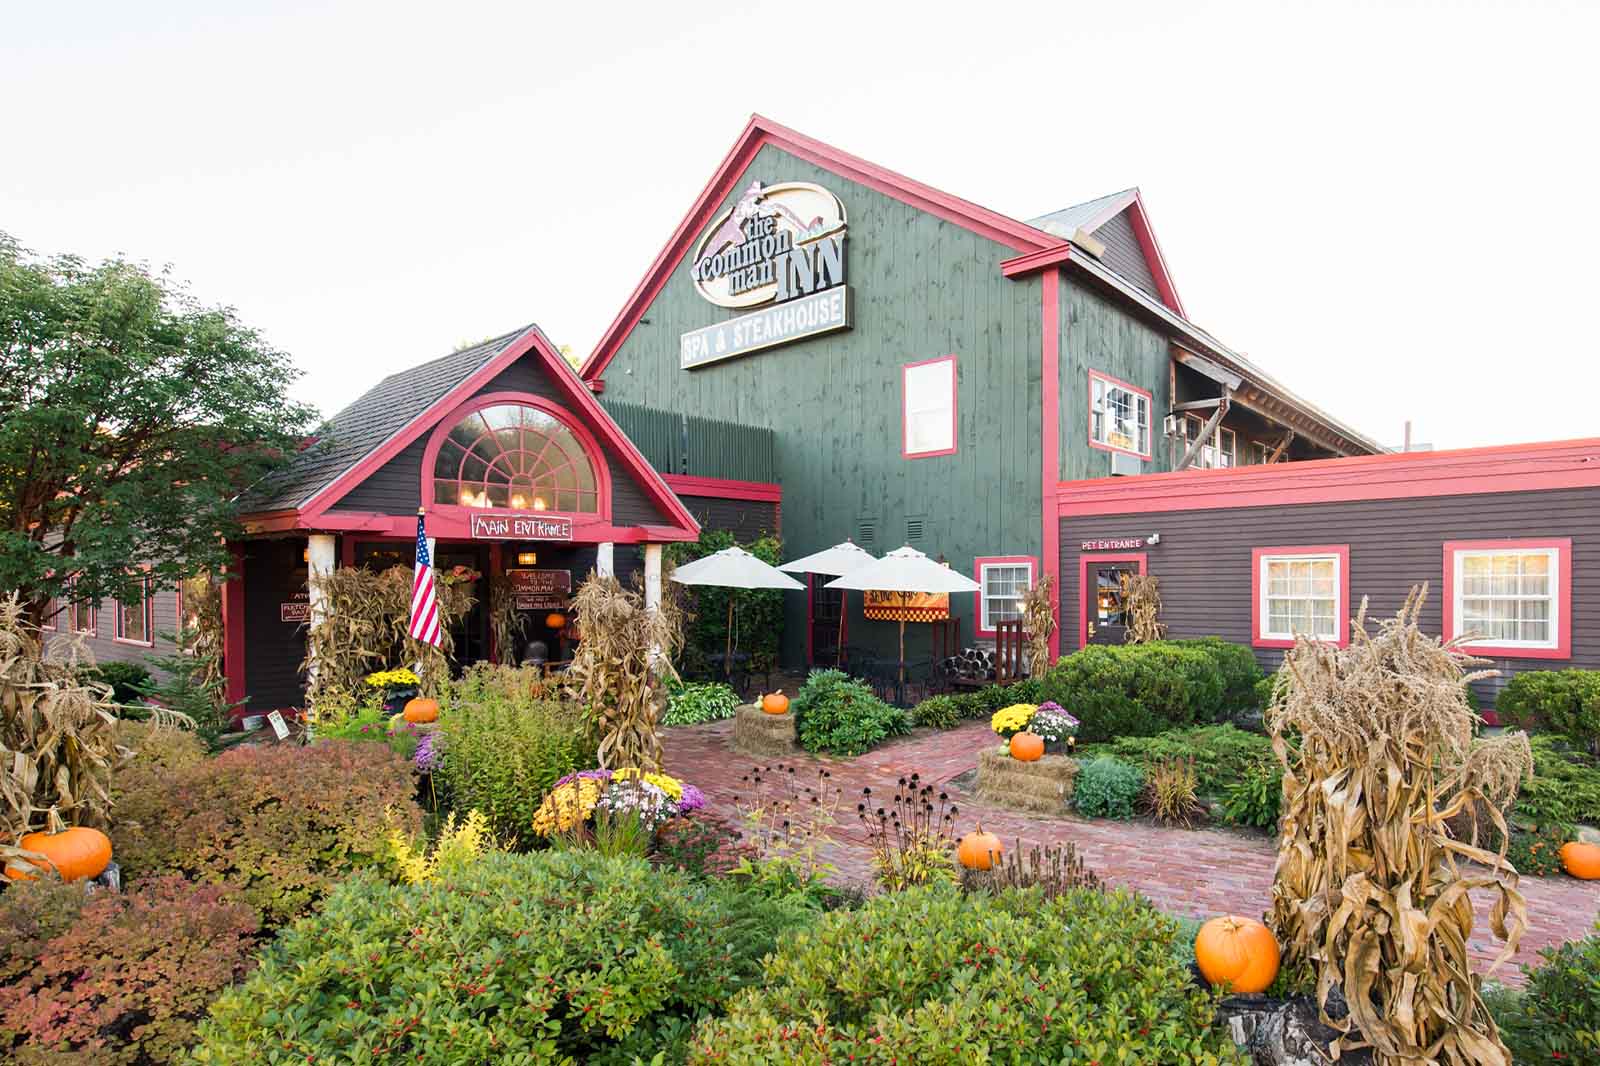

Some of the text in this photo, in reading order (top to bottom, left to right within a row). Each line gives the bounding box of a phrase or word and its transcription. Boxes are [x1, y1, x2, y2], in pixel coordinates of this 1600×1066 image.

[746, 212, 777, 239] the
[699, 230, 792, 282] common
[728, 231, 848, 302] man INN
[683, 294, 842, 361] SPA & STEAKHOUSE
[475, 517, 569, 537] MAIN ENTRANCE
[1082, 539, 1141, 550] PET ENTRANCE
